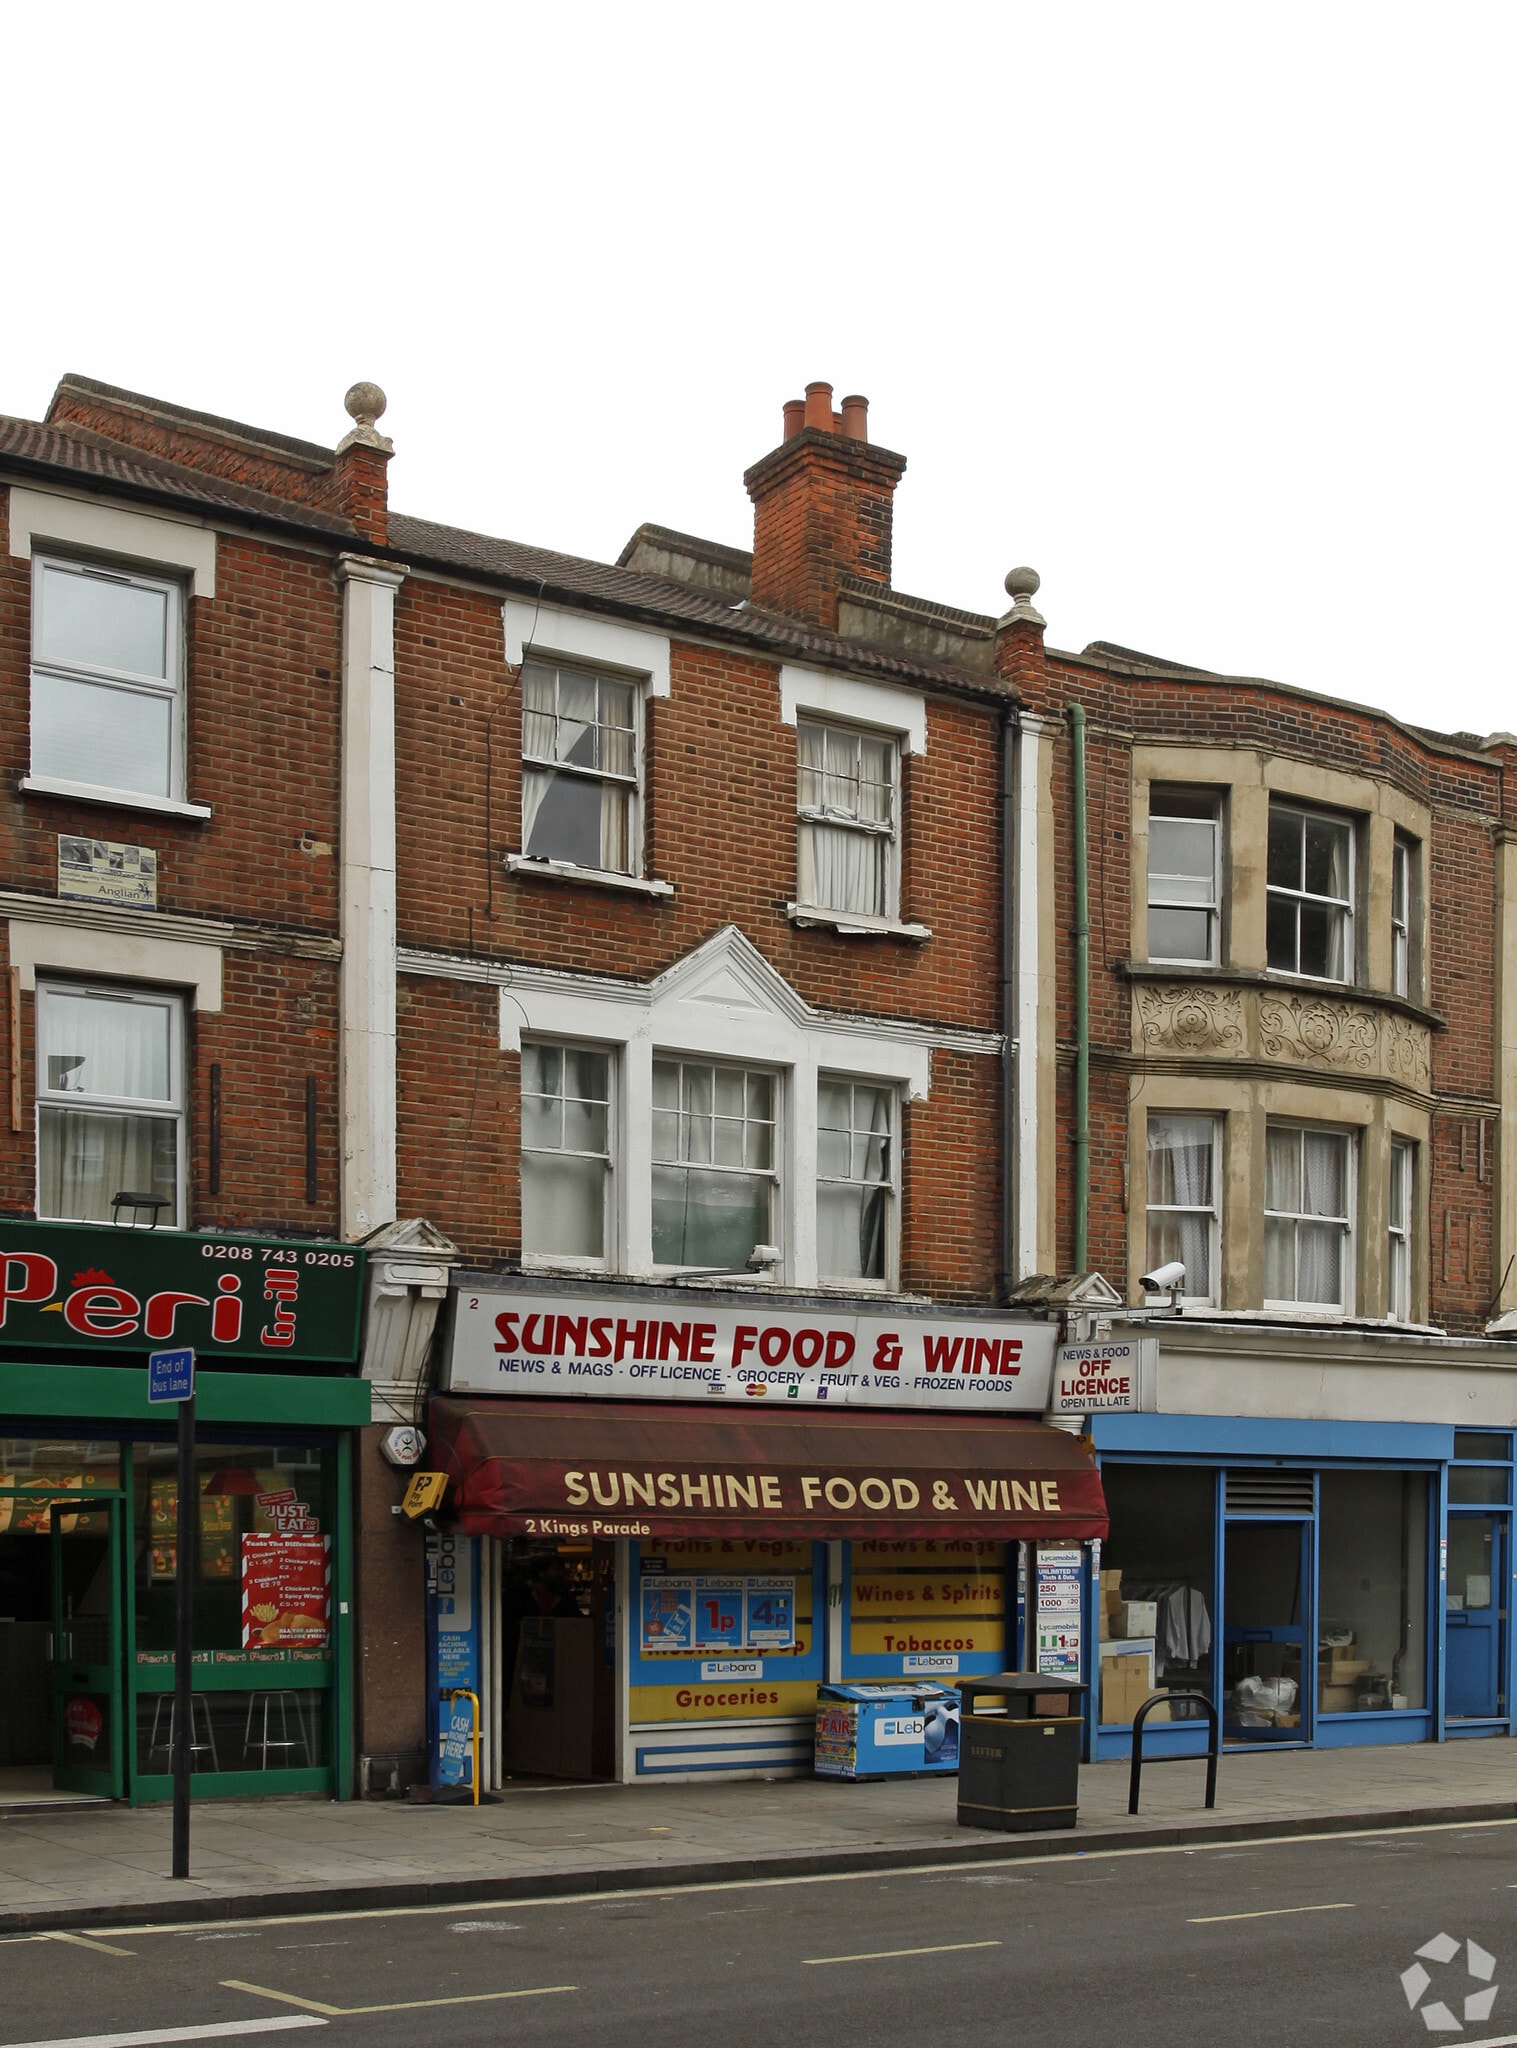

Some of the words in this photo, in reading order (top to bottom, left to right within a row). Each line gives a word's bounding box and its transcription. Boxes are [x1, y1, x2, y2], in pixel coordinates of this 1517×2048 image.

[98, 885, 140, 899] Anglian
[201, 1244, 253, 1261] 0208
[261, 1249, 298, 1264] 743
[304, 1252, 355, 1267] 0205
[260, 1268, 300, 1347] Grill
[469, 1298, 479, 1310] 2
[493, 1312, 717, 1364] SUNSHINE
[731, 1325, 856, 1369] FOOD
[873, 1333, 904, 1371] &
[923, 1335, 1024, 1376] WINE
[1063, 1349, 1091, 1360] NEWS
[1093, 1350, 1099, 1358] &
[1102, 1346, 1130, 1358] FOOD
[156, 1360, 172, 1375] End
[175, 1358, 185, 1372] of
[1079, 1359, 1112, 1377] OFF
[499, 1358, 545, 1373] NEWS
[551, 1361, 562, 1374] &
[567, 1362, 614, 1377] MAGS
[629, 1364, 658, 1379] OFF
[660, 1366, 722, 1381] LICENCE
[737, 1369, 805, 1385] GROCERY
[819, 1373, 858, 1388] FRUIT
[860, 1374, 870, 1387] &
[873, 1375, 901, 1388] VEG
[913, 1377, 966, 1391] FROZEN
[968, 1379, 1013, 1392] FOODS
[153, 1379, 167, 1392] bus
[170, 1377, 188, 1390] lane
[1060, 1377, 1130, 1396] LICENCE
[1060, 1398, 1085, 1408] OPEN
[1087, 1397, 1106, 1407] TILL
[1107, 1395, 1130, 1406] LATE
[564, 1471, 783, 1509] SUNSHINE
[801, 1476, 921, 1511] FOOD
[931, 1480, 959, 1511] &
[964, 1479, 1062, 1512] WINE
[267, 1505, 307, 1517] JUST
[408, 1500, 423, 1508] Point
[278, 1518, 307, 1530] EAT
[525, 1519, 537, 1533] 2
[540, 1519, 588, 1537] Kings
[593, 1520, 650, 1536] Parade
[652, 1538, 713, 1553] Fruits
[720, 1539, 734, 1553] &
[744, 1539, 803, 1556] Vegs.
[862, 1540, 917, 1553] News
[926, 1540, 936, 1553] &
[944, 1540, 995, 1555] Mags
[1041, 1554, 1078, 1562] Lycamobile
[653, 1578, 691, 1588] Lebara
[705, 1578, 743, 1587] Lebara
[756, 1578, 793, 1587] Lebara
[856, 1585, 915, 1602] Wines
[922, 1586, 934, 1601] &
[942, 1584, 1000, 1604] Spirits
[1041, 1599, 1061, 1607] 1000
[705, 1600, 735, 1632] 1p
[752, 1600, 787, 1628] 4p
[884, 1635, 974, 1652] Tobaccos
[137, 1652, 169, 1663] Peri
[216, 1652, 246, 1662] Peri
[250, 1652, 280, 1662] Peri
[294, 1651, 322, 1661] Peri
[918, 1657, 952, 1666] Lebara
[717, 1662, 756, 1672] Lebara
[676, 1688, 779, 1708] Groceries
[450, 1715, 470, 1732] CASH
[821, 1718, 850, 1735] FAIR
[445, 1741, 464, 1759] HERE
[971, 1746, 1002, 1758] LITTER
